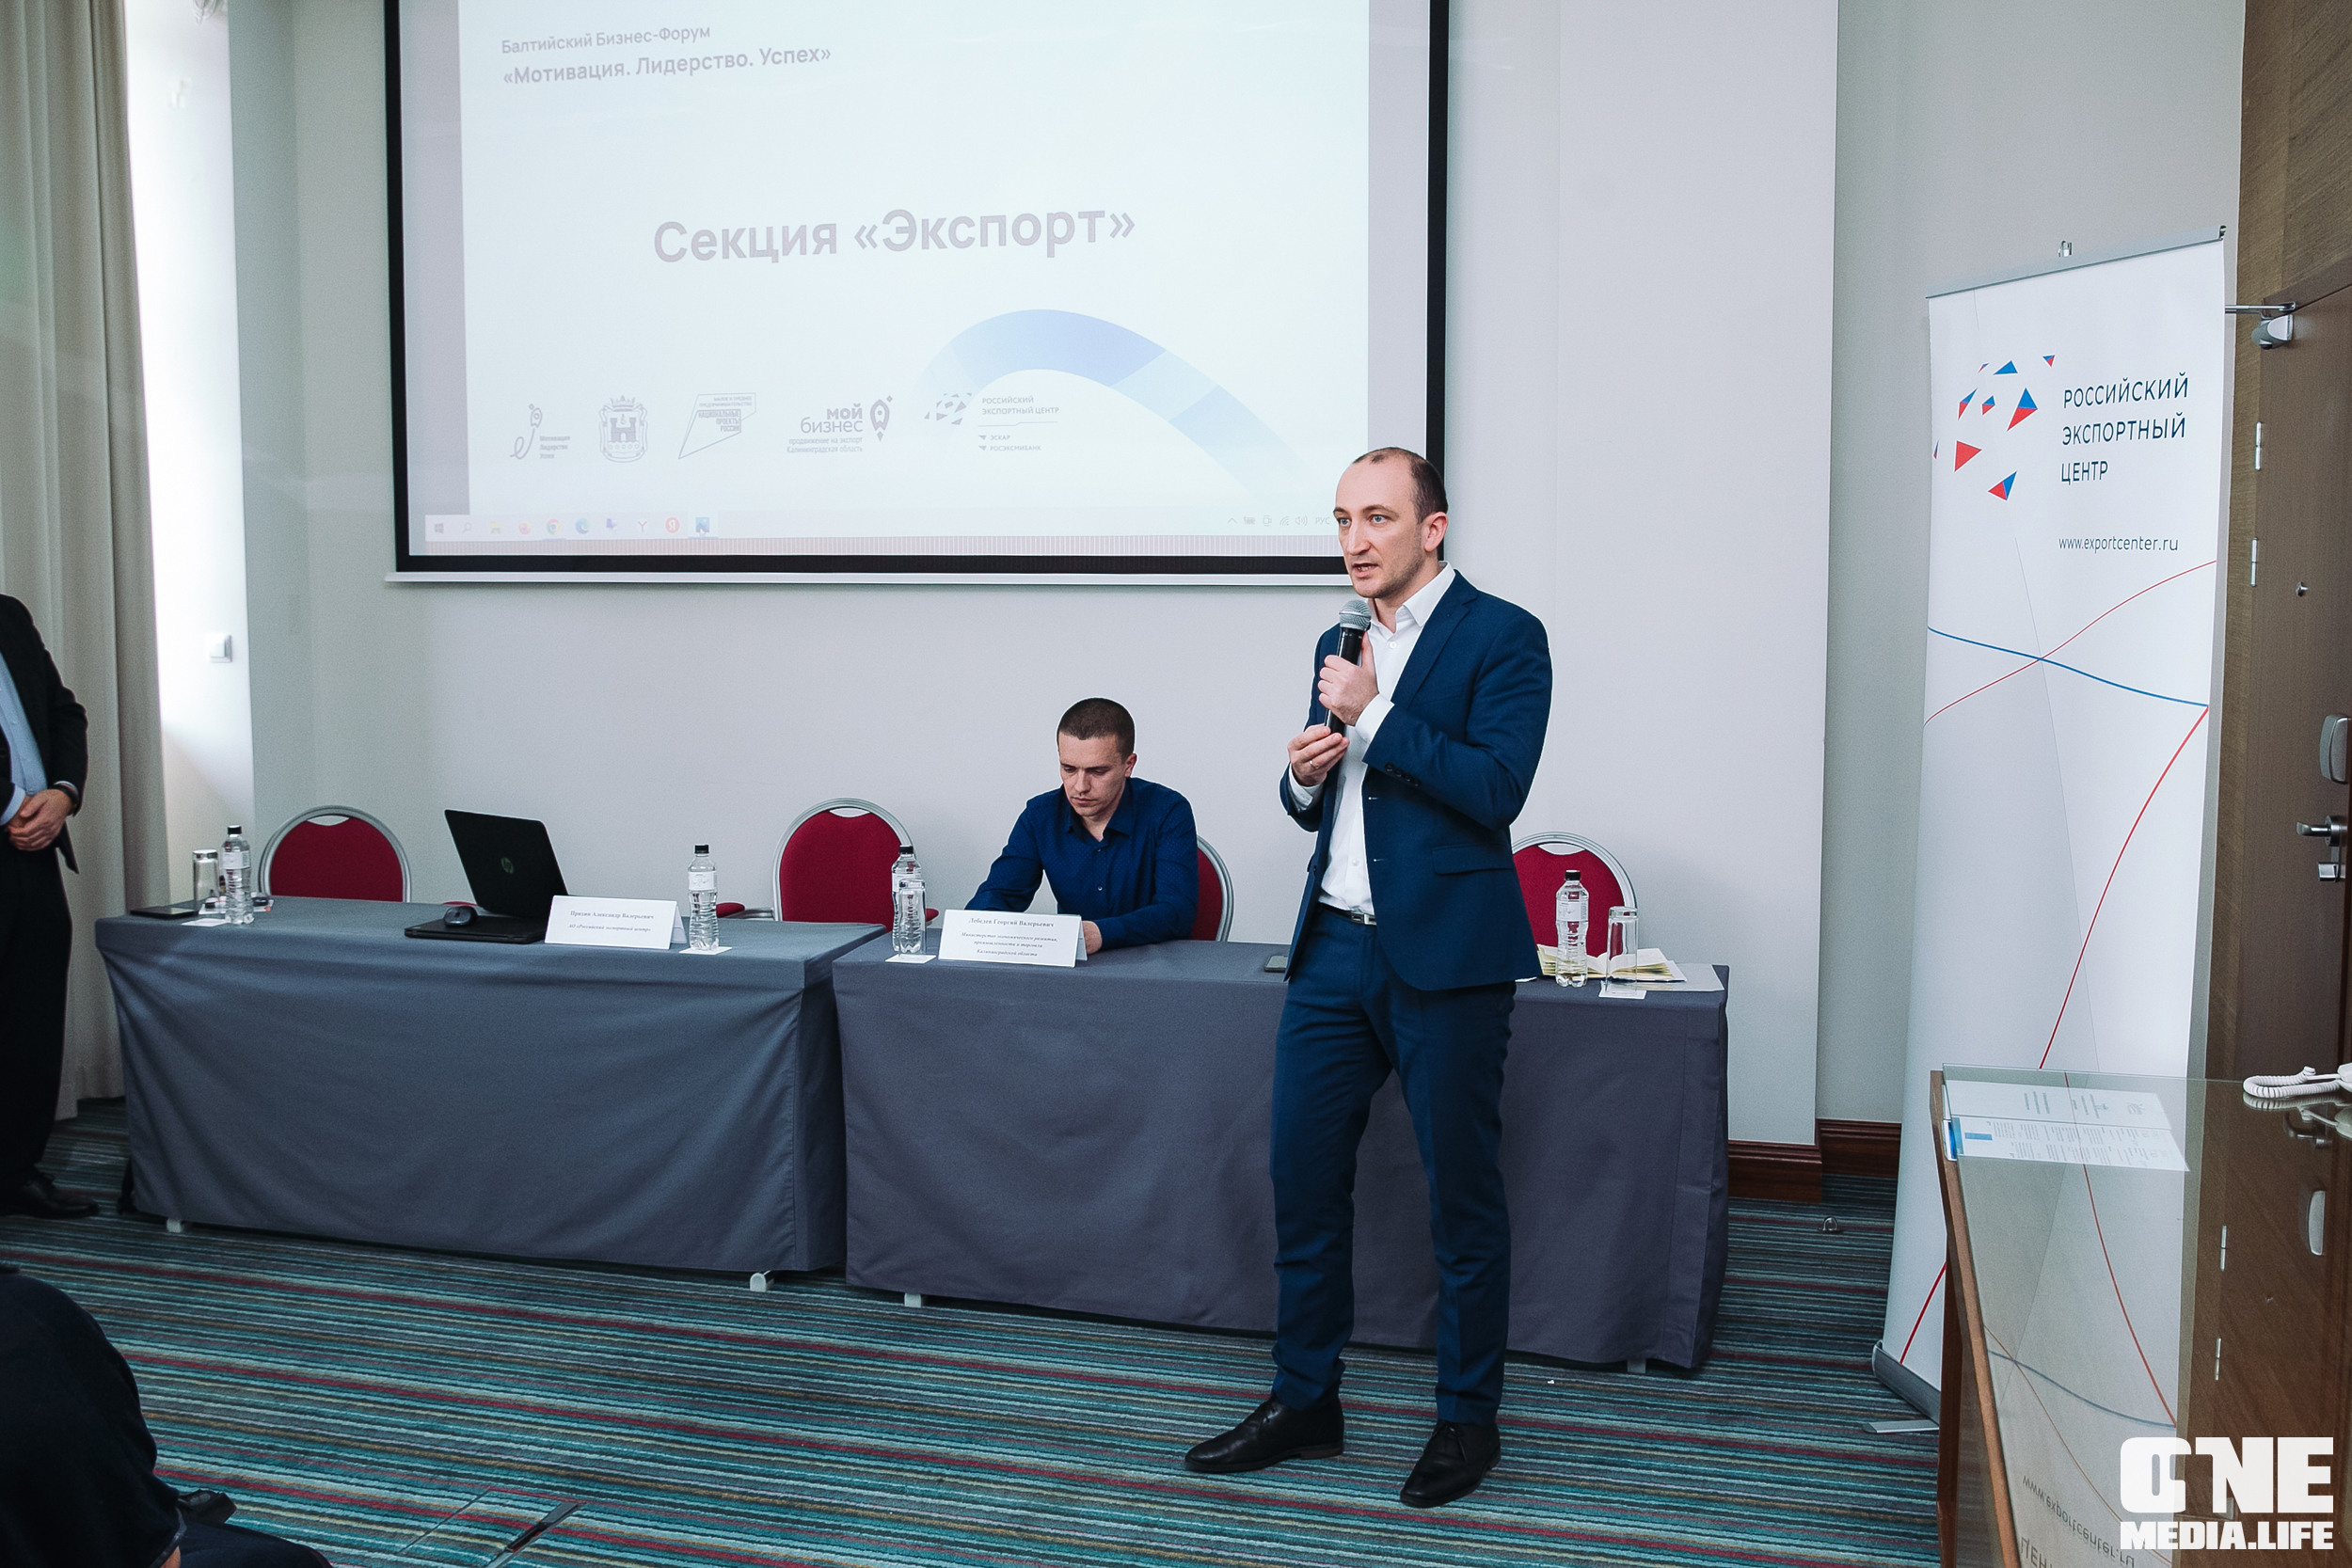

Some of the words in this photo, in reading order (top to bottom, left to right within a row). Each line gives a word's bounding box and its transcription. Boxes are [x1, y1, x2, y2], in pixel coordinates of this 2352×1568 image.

[501, 32, 594, 55] Балтийский
[596, 24, 711, 47] Бизнес-Форум
[502, 61, 632, 86] «Мотивация.
[635, 52, 755, 75] Лидерство.
[758, 45, 832, 66] Успех»
[654, 220, 838, 263] Секция
[853, 209, 1136, 259] «Экспорт»
[981, 396, 1035, 404] РОССИЙСКИЙ
[2063, 372, 2188, 409] РОССИЙСКИЙ
[800, 416, 864, 434] бизнес
[981, 406, 1034, 416] ЭКСПОРТНЫЙ
[1035, 406, 1060, 415] ЦЕНТР
[2061, 411, 2185, 446] ЭКСПОРТНЫЙ
[2060, 460, 2108, 485] ЦЕНТР
[2058, 535, 2179, 553] www.exportcenter.ru
